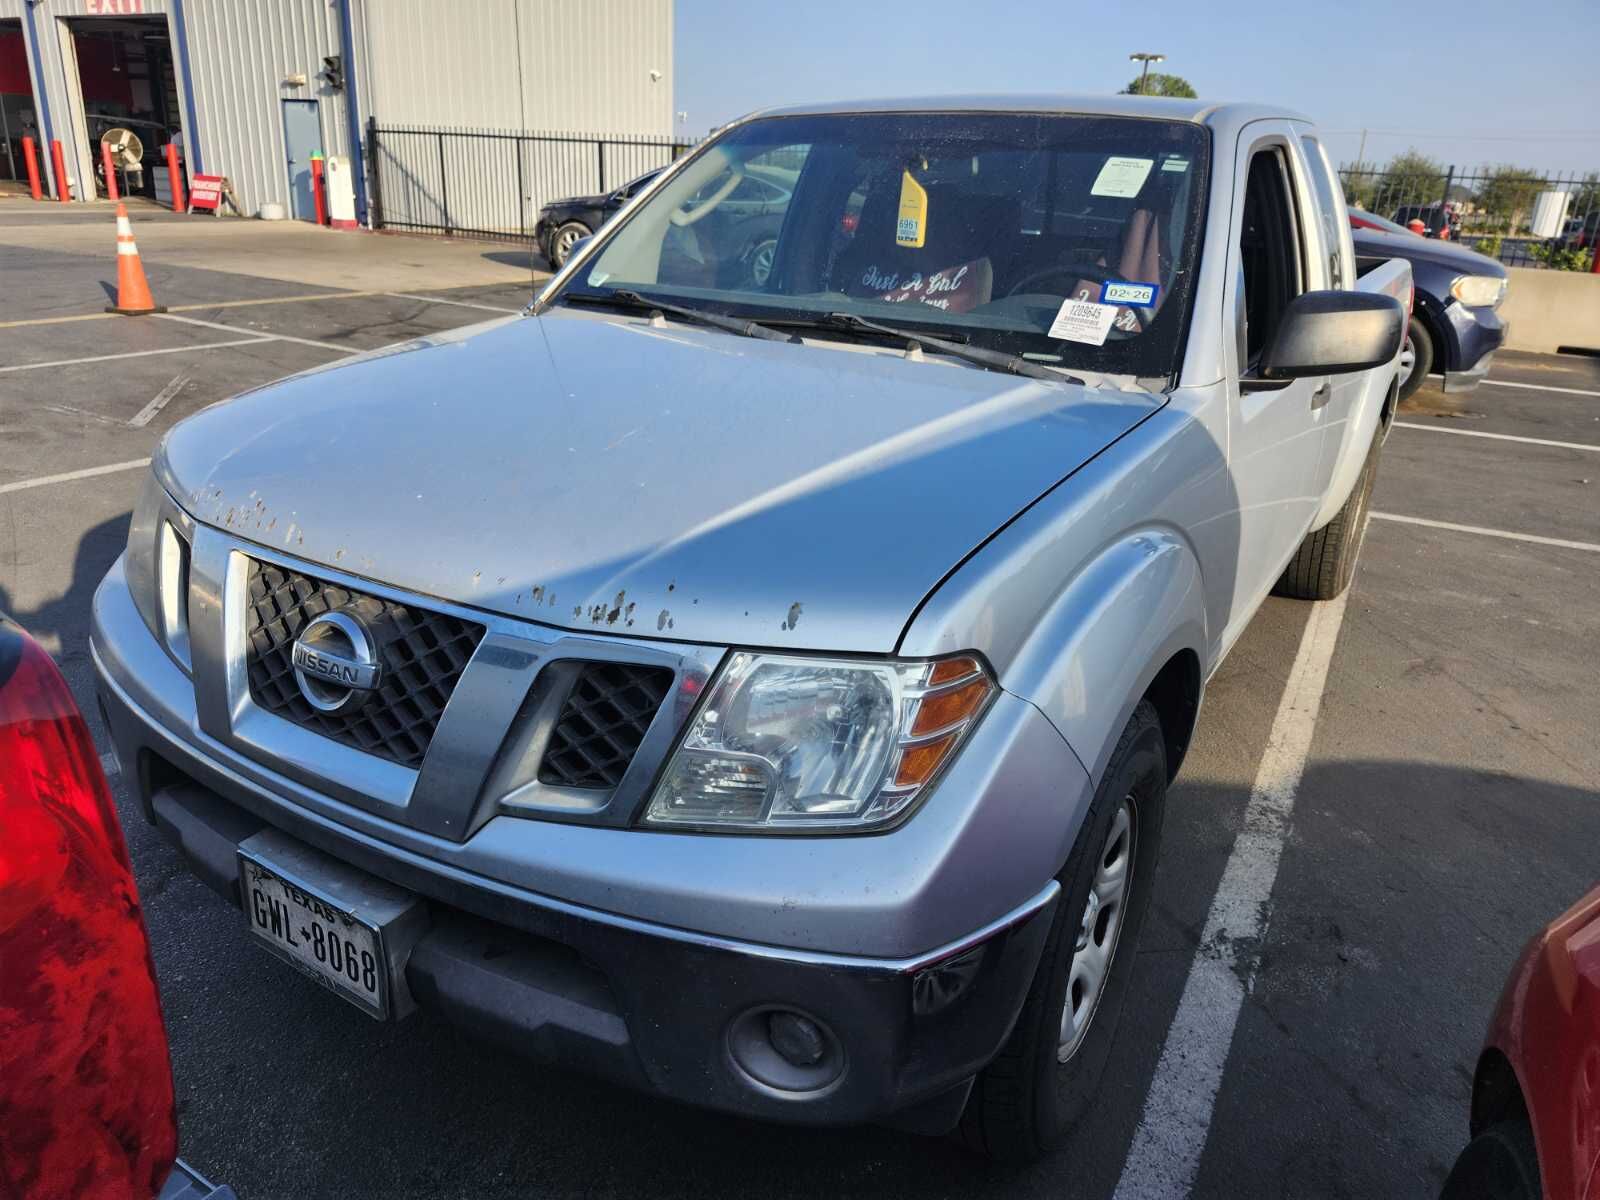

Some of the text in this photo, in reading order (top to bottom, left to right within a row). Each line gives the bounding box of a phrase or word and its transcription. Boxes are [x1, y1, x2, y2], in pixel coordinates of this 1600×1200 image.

[899, 219, 918, 229] 6961
[862, 265, 968, 295] Just A Girl
[1069, 304, 1102, 319] 1209645
[294, 646, 360, 682] NISSAN
[280, 881, 336, 923] TEXAS
